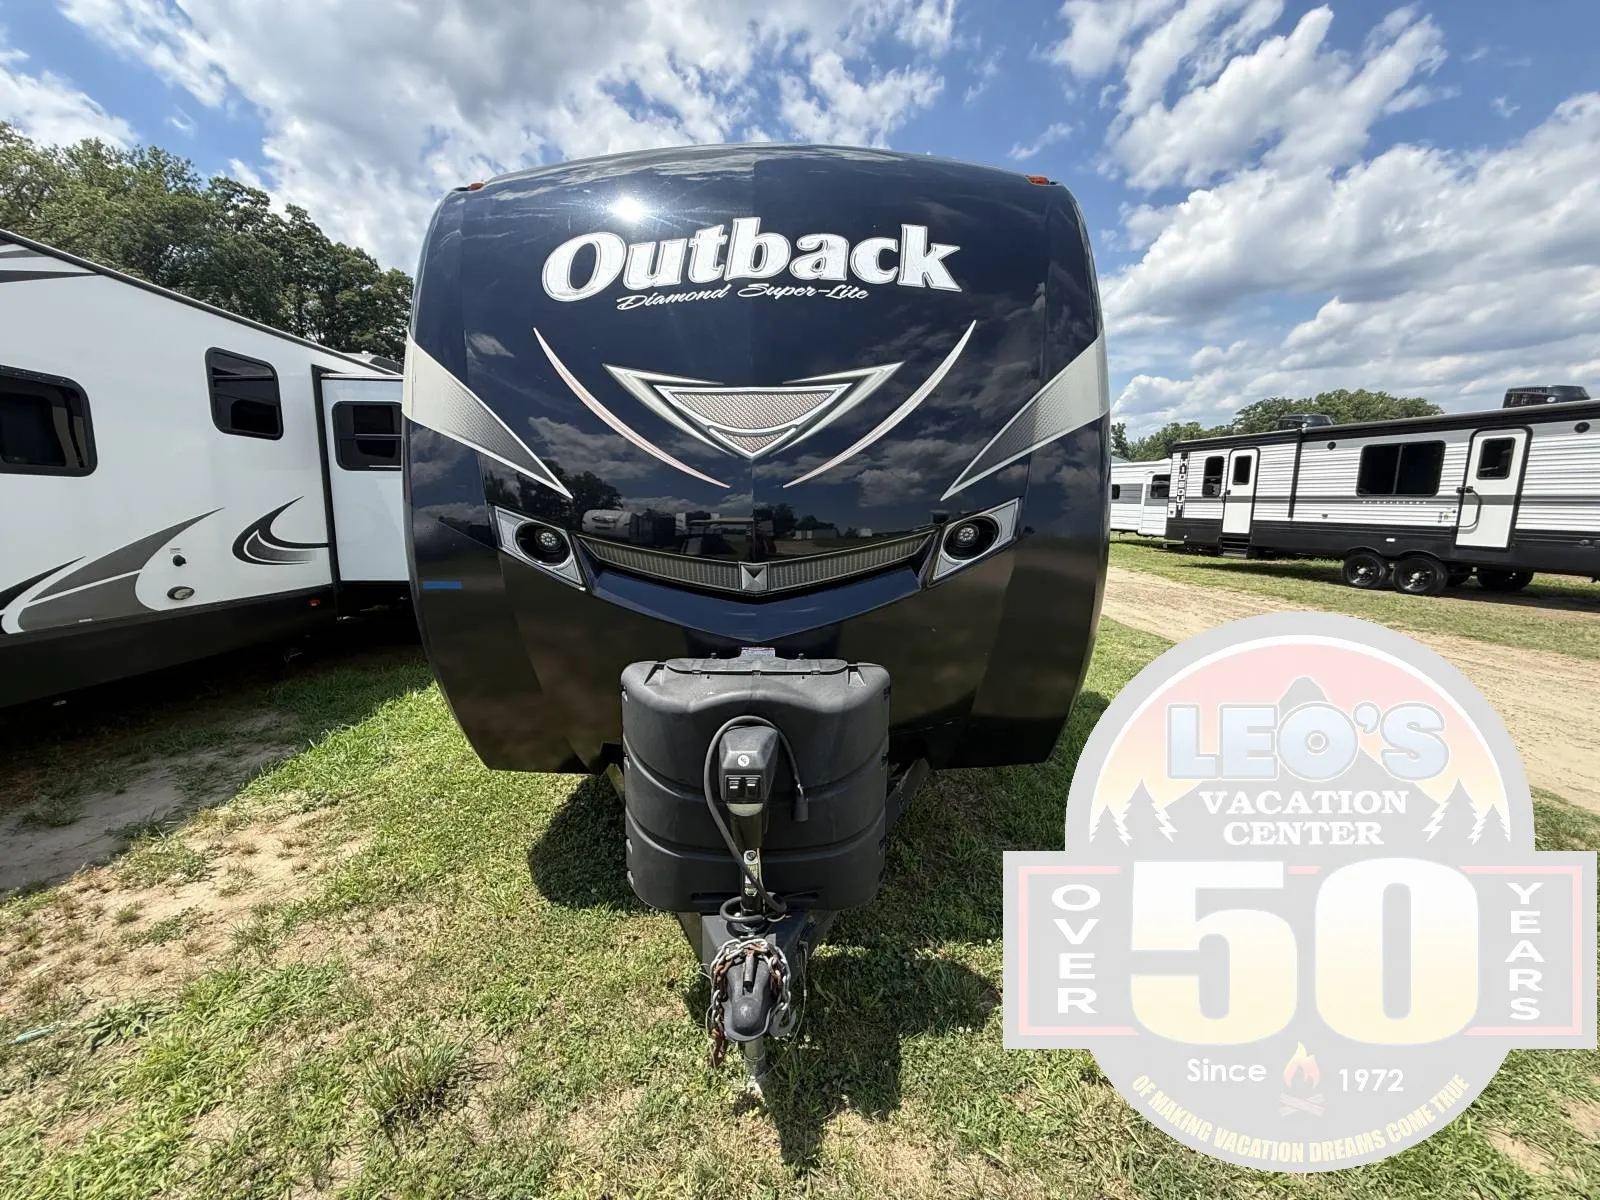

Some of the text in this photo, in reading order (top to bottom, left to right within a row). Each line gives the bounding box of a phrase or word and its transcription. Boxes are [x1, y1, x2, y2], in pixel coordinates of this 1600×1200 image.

[541, 216, 963, 302] Outback
[617, 283, 869, 310] Diamond Super-Lite
[1176, 458, 1188, 510] HIDEOUT
